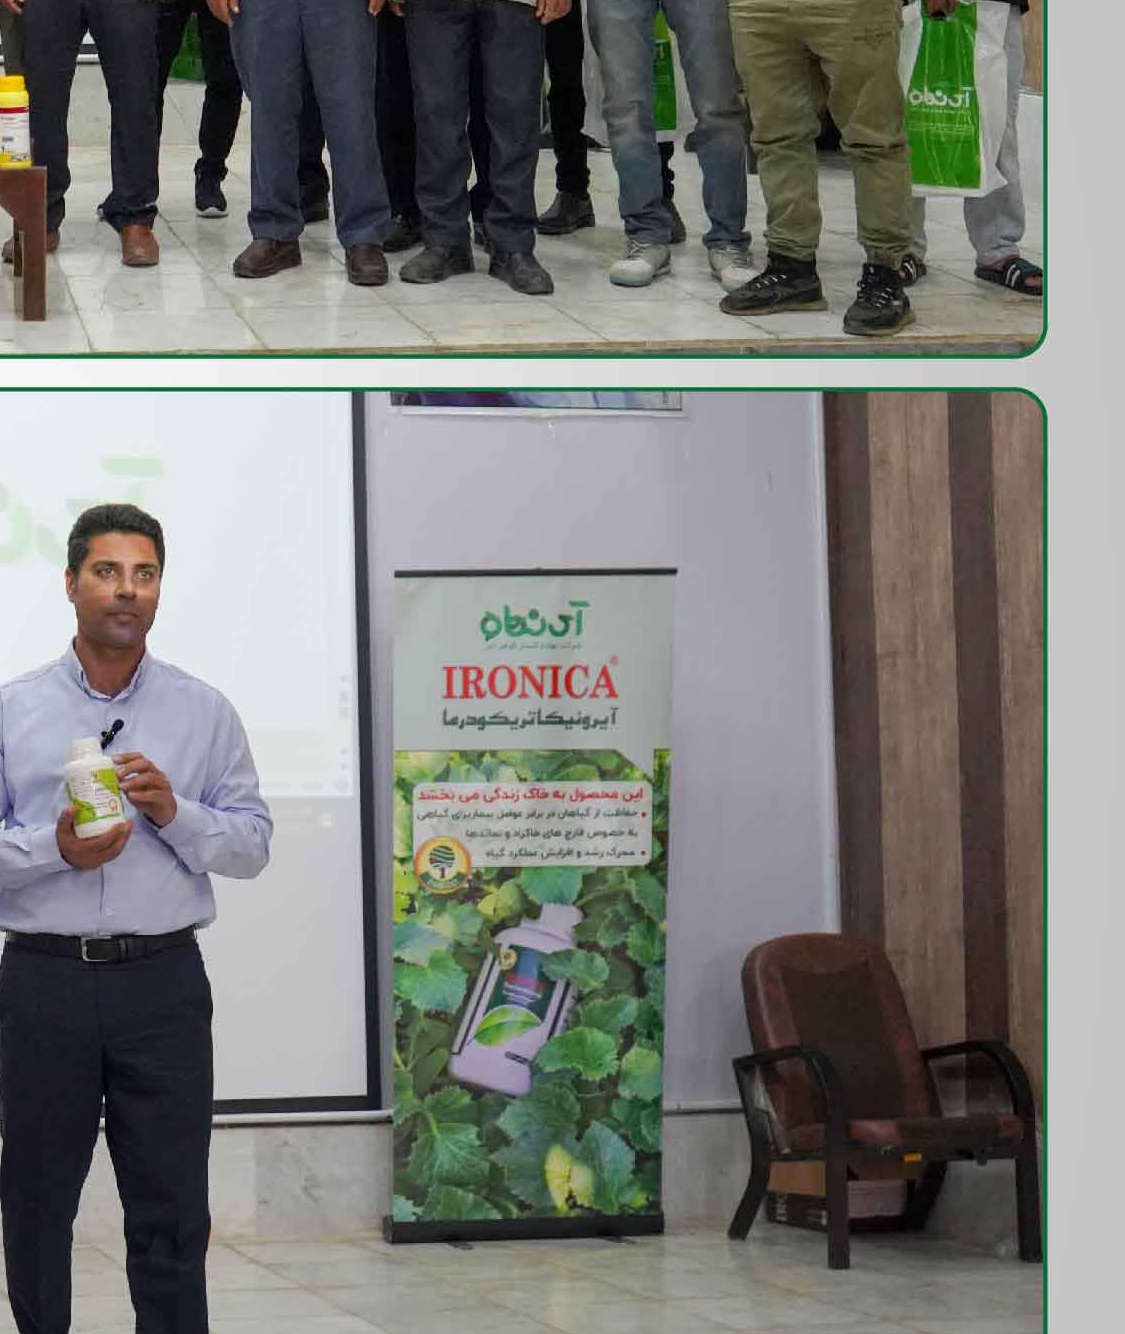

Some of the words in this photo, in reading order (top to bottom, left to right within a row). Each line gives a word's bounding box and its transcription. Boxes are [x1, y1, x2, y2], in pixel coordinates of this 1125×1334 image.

[443, 665, 619, 699] IRONICA
[570, 787, 620, 803] محصول
[623, 787, 643, 803] این
